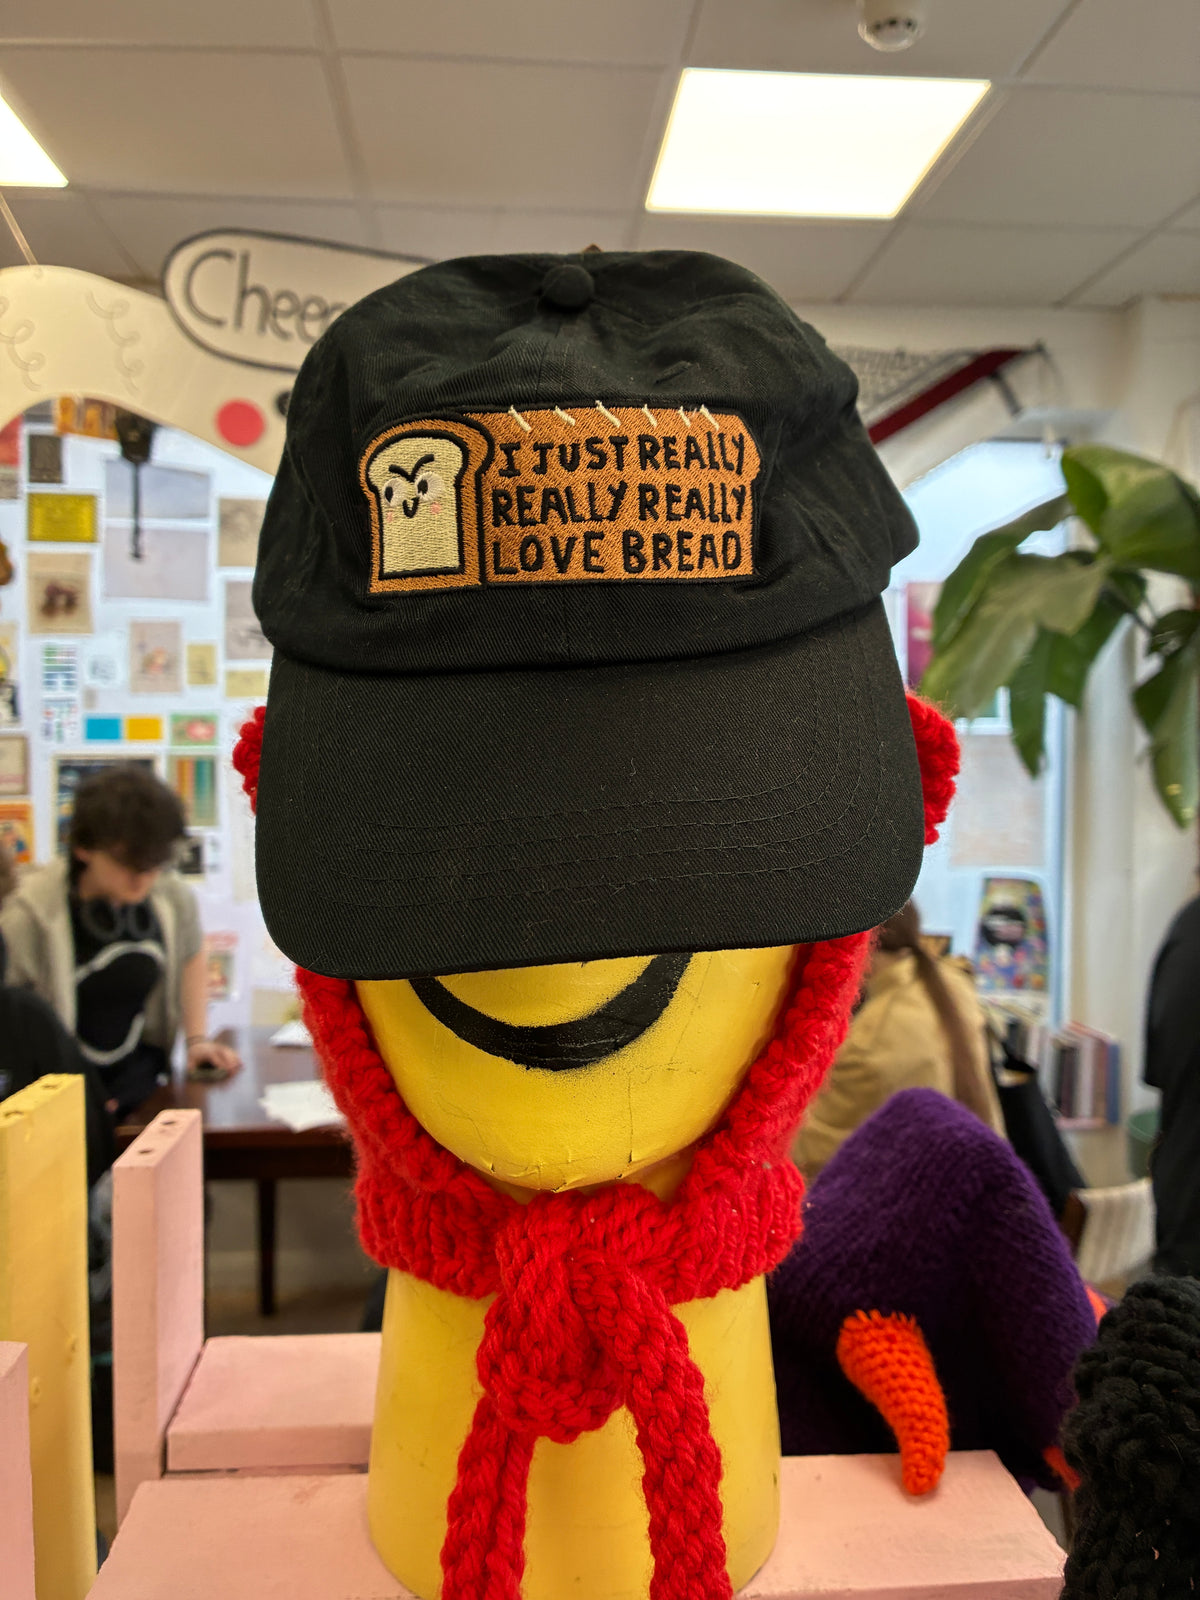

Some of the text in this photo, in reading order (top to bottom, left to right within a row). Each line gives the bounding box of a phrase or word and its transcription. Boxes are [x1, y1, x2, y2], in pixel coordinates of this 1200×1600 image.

[498, 431, 745, 478] I JUST REALLY
[491, 481, 746, 528] REALLY REALLY
[492, 529, 741, 575] LOVE BREAD
